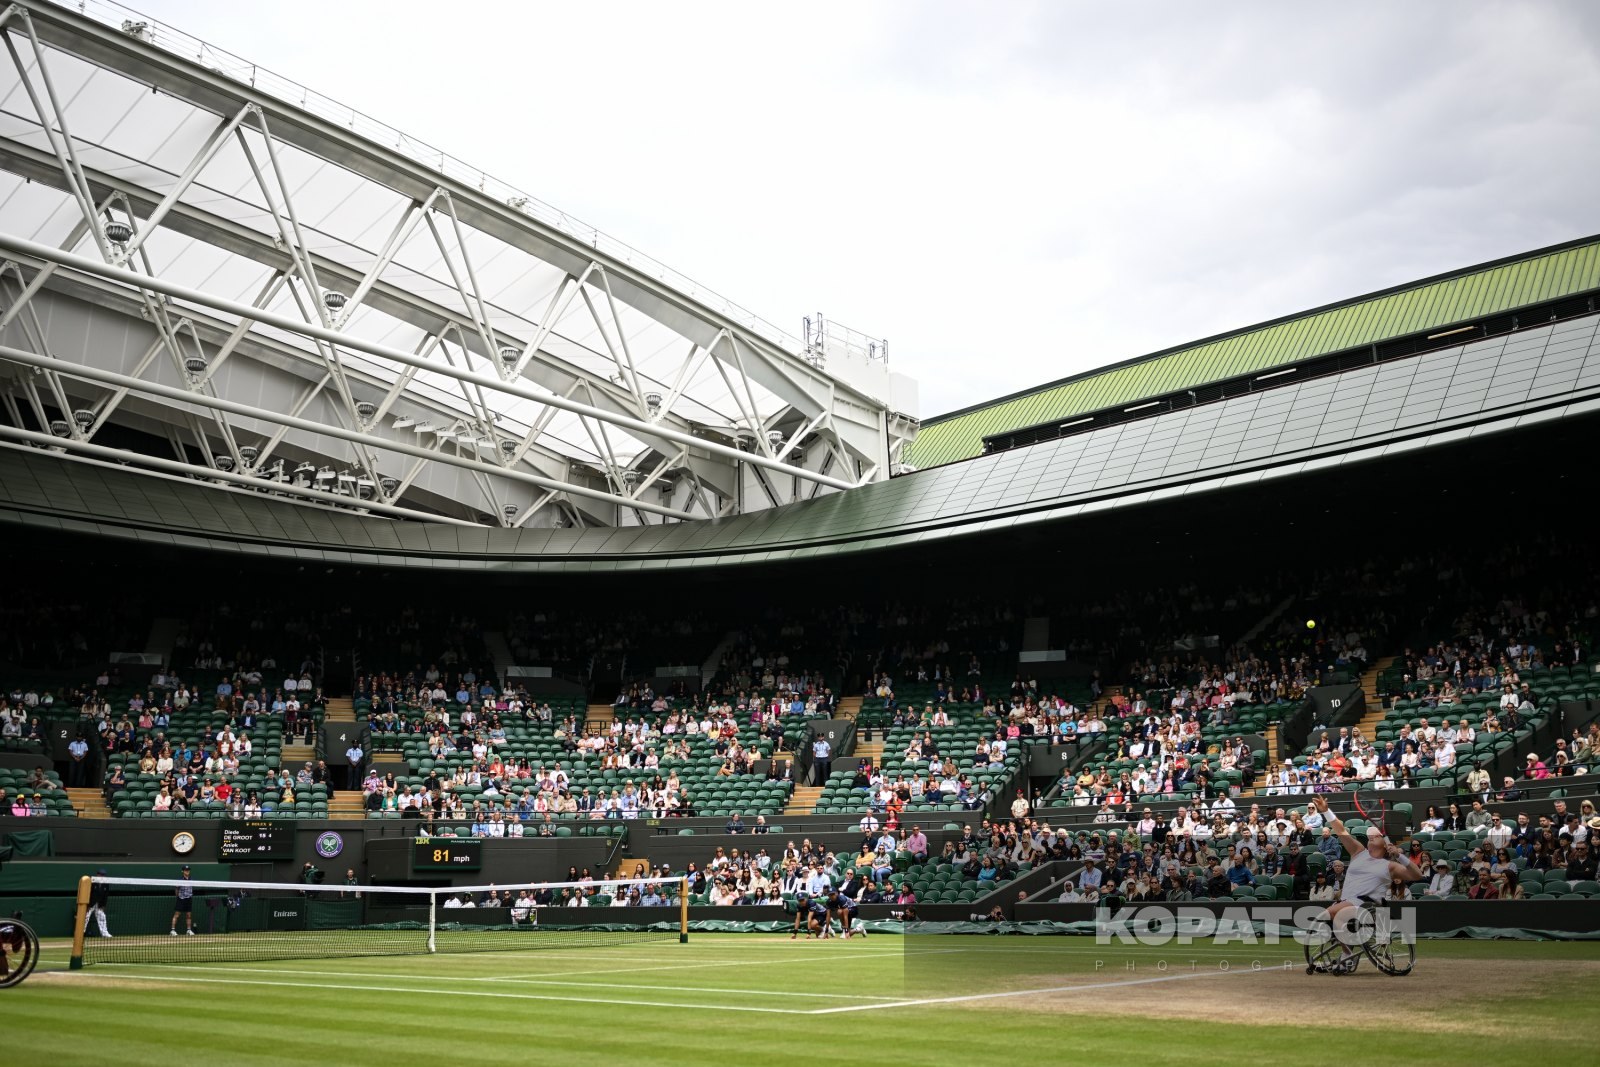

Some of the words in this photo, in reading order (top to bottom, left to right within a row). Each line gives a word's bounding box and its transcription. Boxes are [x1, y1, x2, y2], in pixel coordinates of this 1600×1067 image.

[1330, 698, 1341, 708] 10
[60, 729, 68, 739] 2
[339, 733, 347, 742] 4
[828, 730, 835, 739] 6
[415, 837, 430, 845] IBM
[433, 849, 449, 862] 81
[453, 855, 470, 863] mph
[273, 910, 298, 918] Emirates
